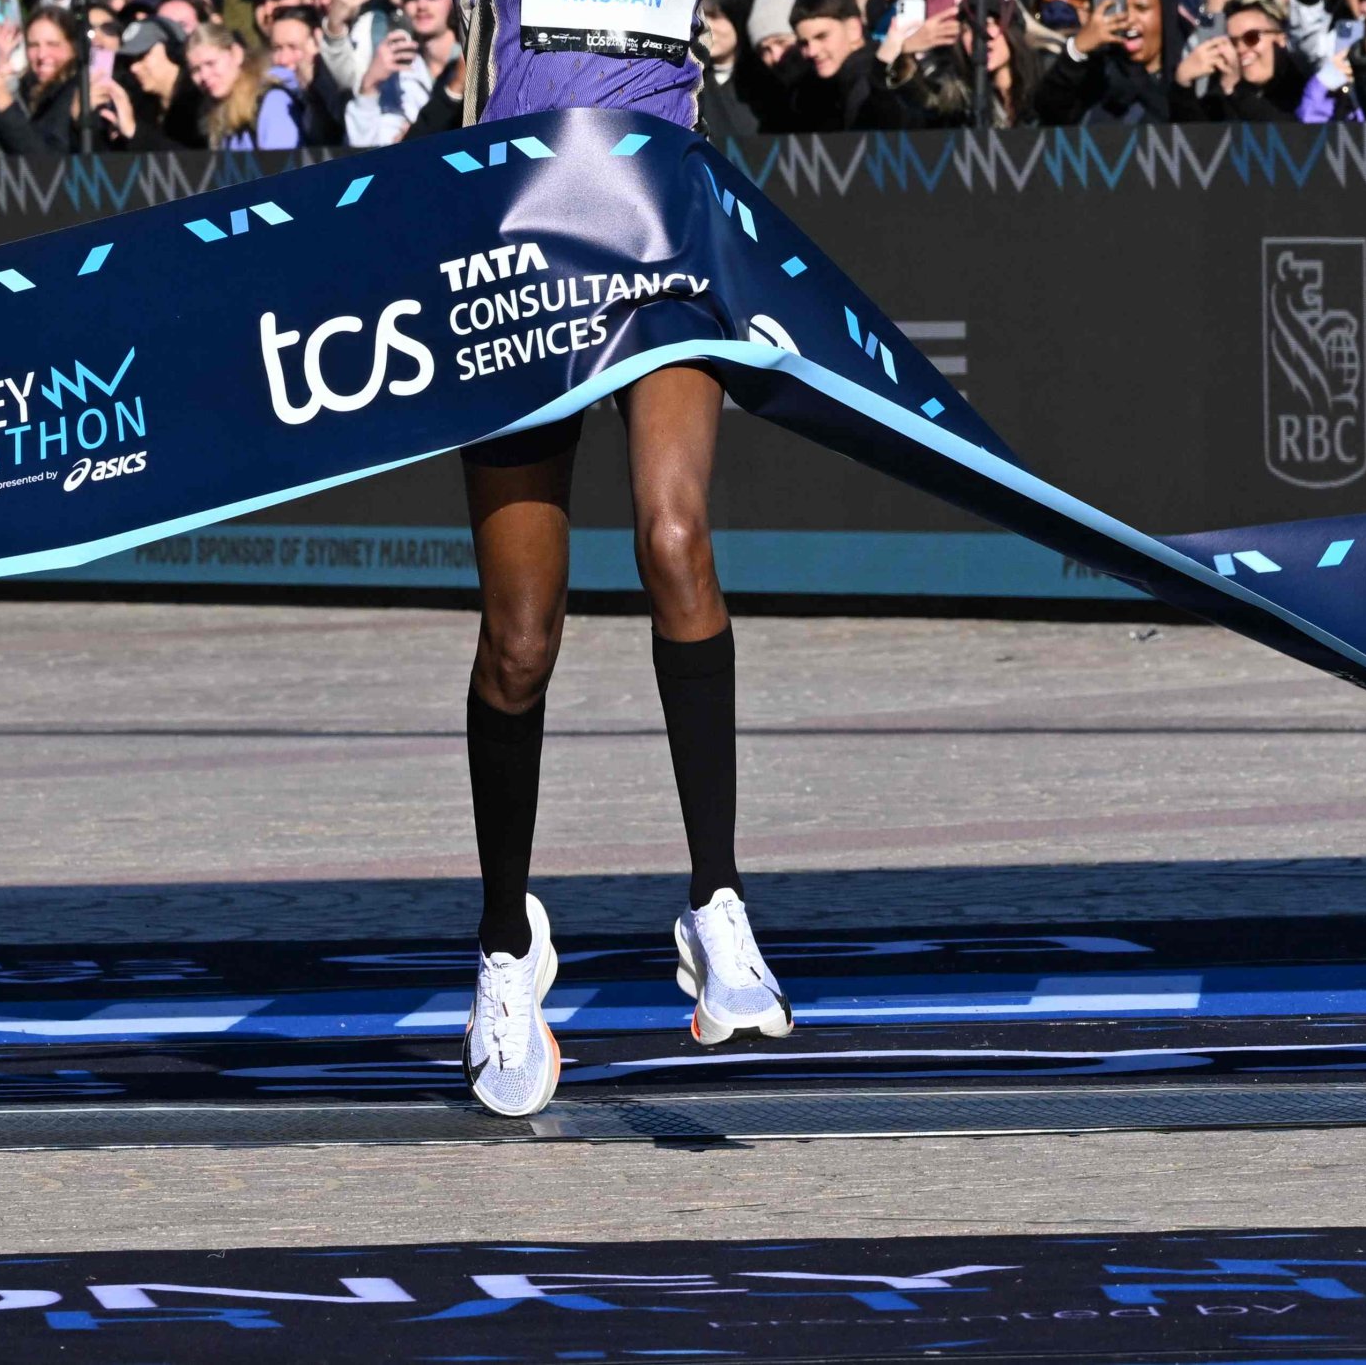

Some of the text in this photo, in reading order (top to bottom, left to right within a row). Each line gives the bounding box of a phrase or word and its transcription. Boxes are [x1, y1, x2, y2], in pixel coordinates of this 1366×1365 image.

[440, 242, 549, 292] TATA
[449, 273, 710, 336] CONSULTANCY
[456, 315, 608, 381] SERVICES
[1278, 414, 1359, 465] RBC
[46, 471, 58, 480] by
[91, 451, 147, 482] asics
[134, 537, 192, 565] PROUD
[196, 536, 276, 566] SPONSOR
[280, 537, 301, 566] OF
[306, 538, 374, 568] SYDNEY
[1195, 1304, 1297, 1317] by
